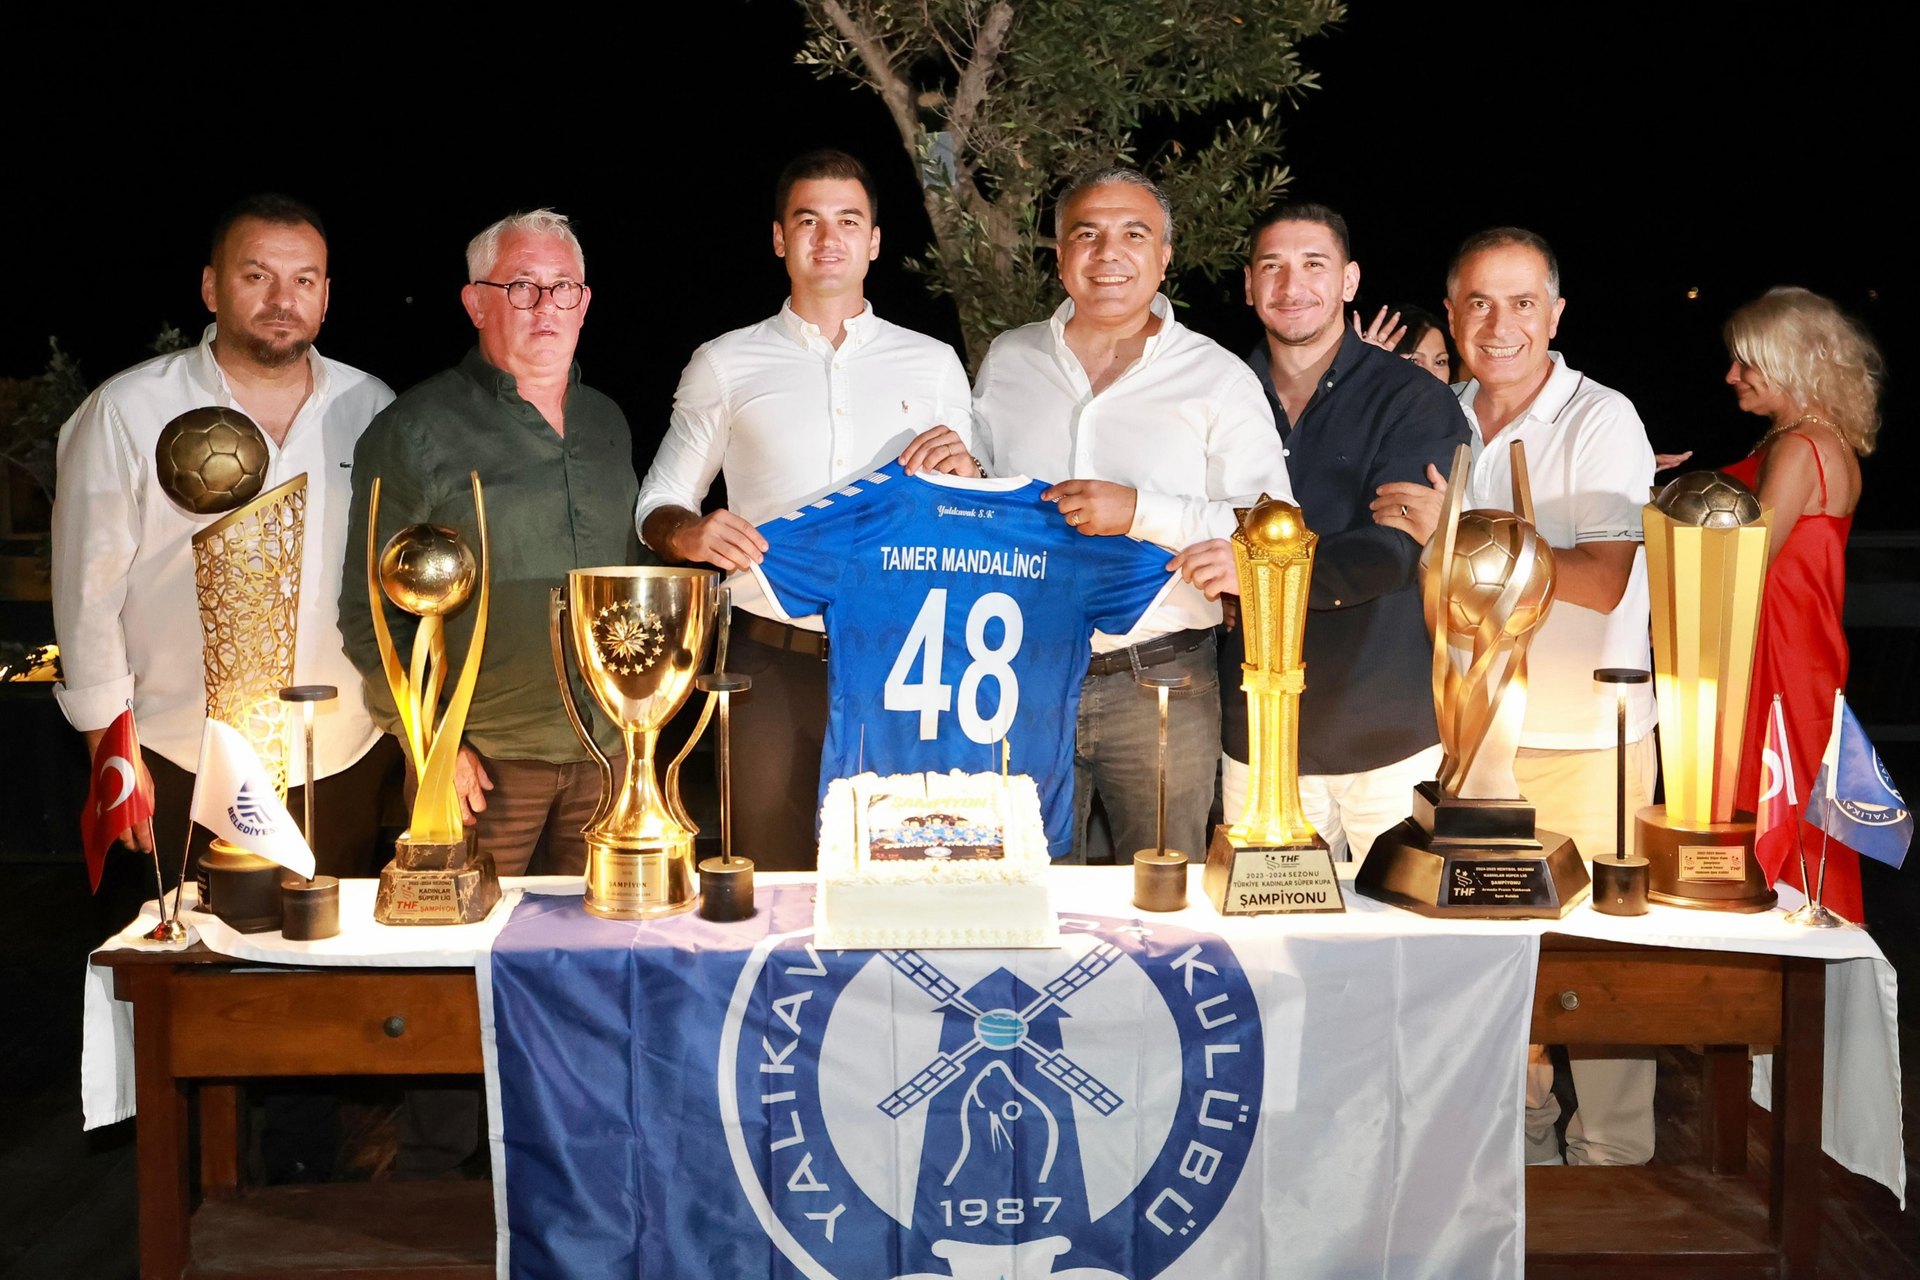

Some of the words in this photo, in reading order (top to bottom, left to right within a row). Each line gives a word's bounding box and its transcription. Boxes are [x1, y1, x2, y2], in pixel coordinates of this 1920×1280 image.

[880, 546, 938, 571] TAMER
[941, 547, 1047, 580] MANDALİNCİ
[883, 588, 1024, 745] 48
[1280, 855, 1300, 863] THF
[1288, 870, 1320, 878] SEZONU
[1233, 880, 1259, 888] TÜRKİYE
[1294, 878, 1314, 886] SÜPER
[1240, 889, 1327, 909] ŞAMPİYONU
[1453, 887, 1476, 897] THF
[396, 900, 419, 909] THF
[1145, 943, 1249, 1237] KULÜBÜ
[940, 1197, 1062, 1227] 1987
